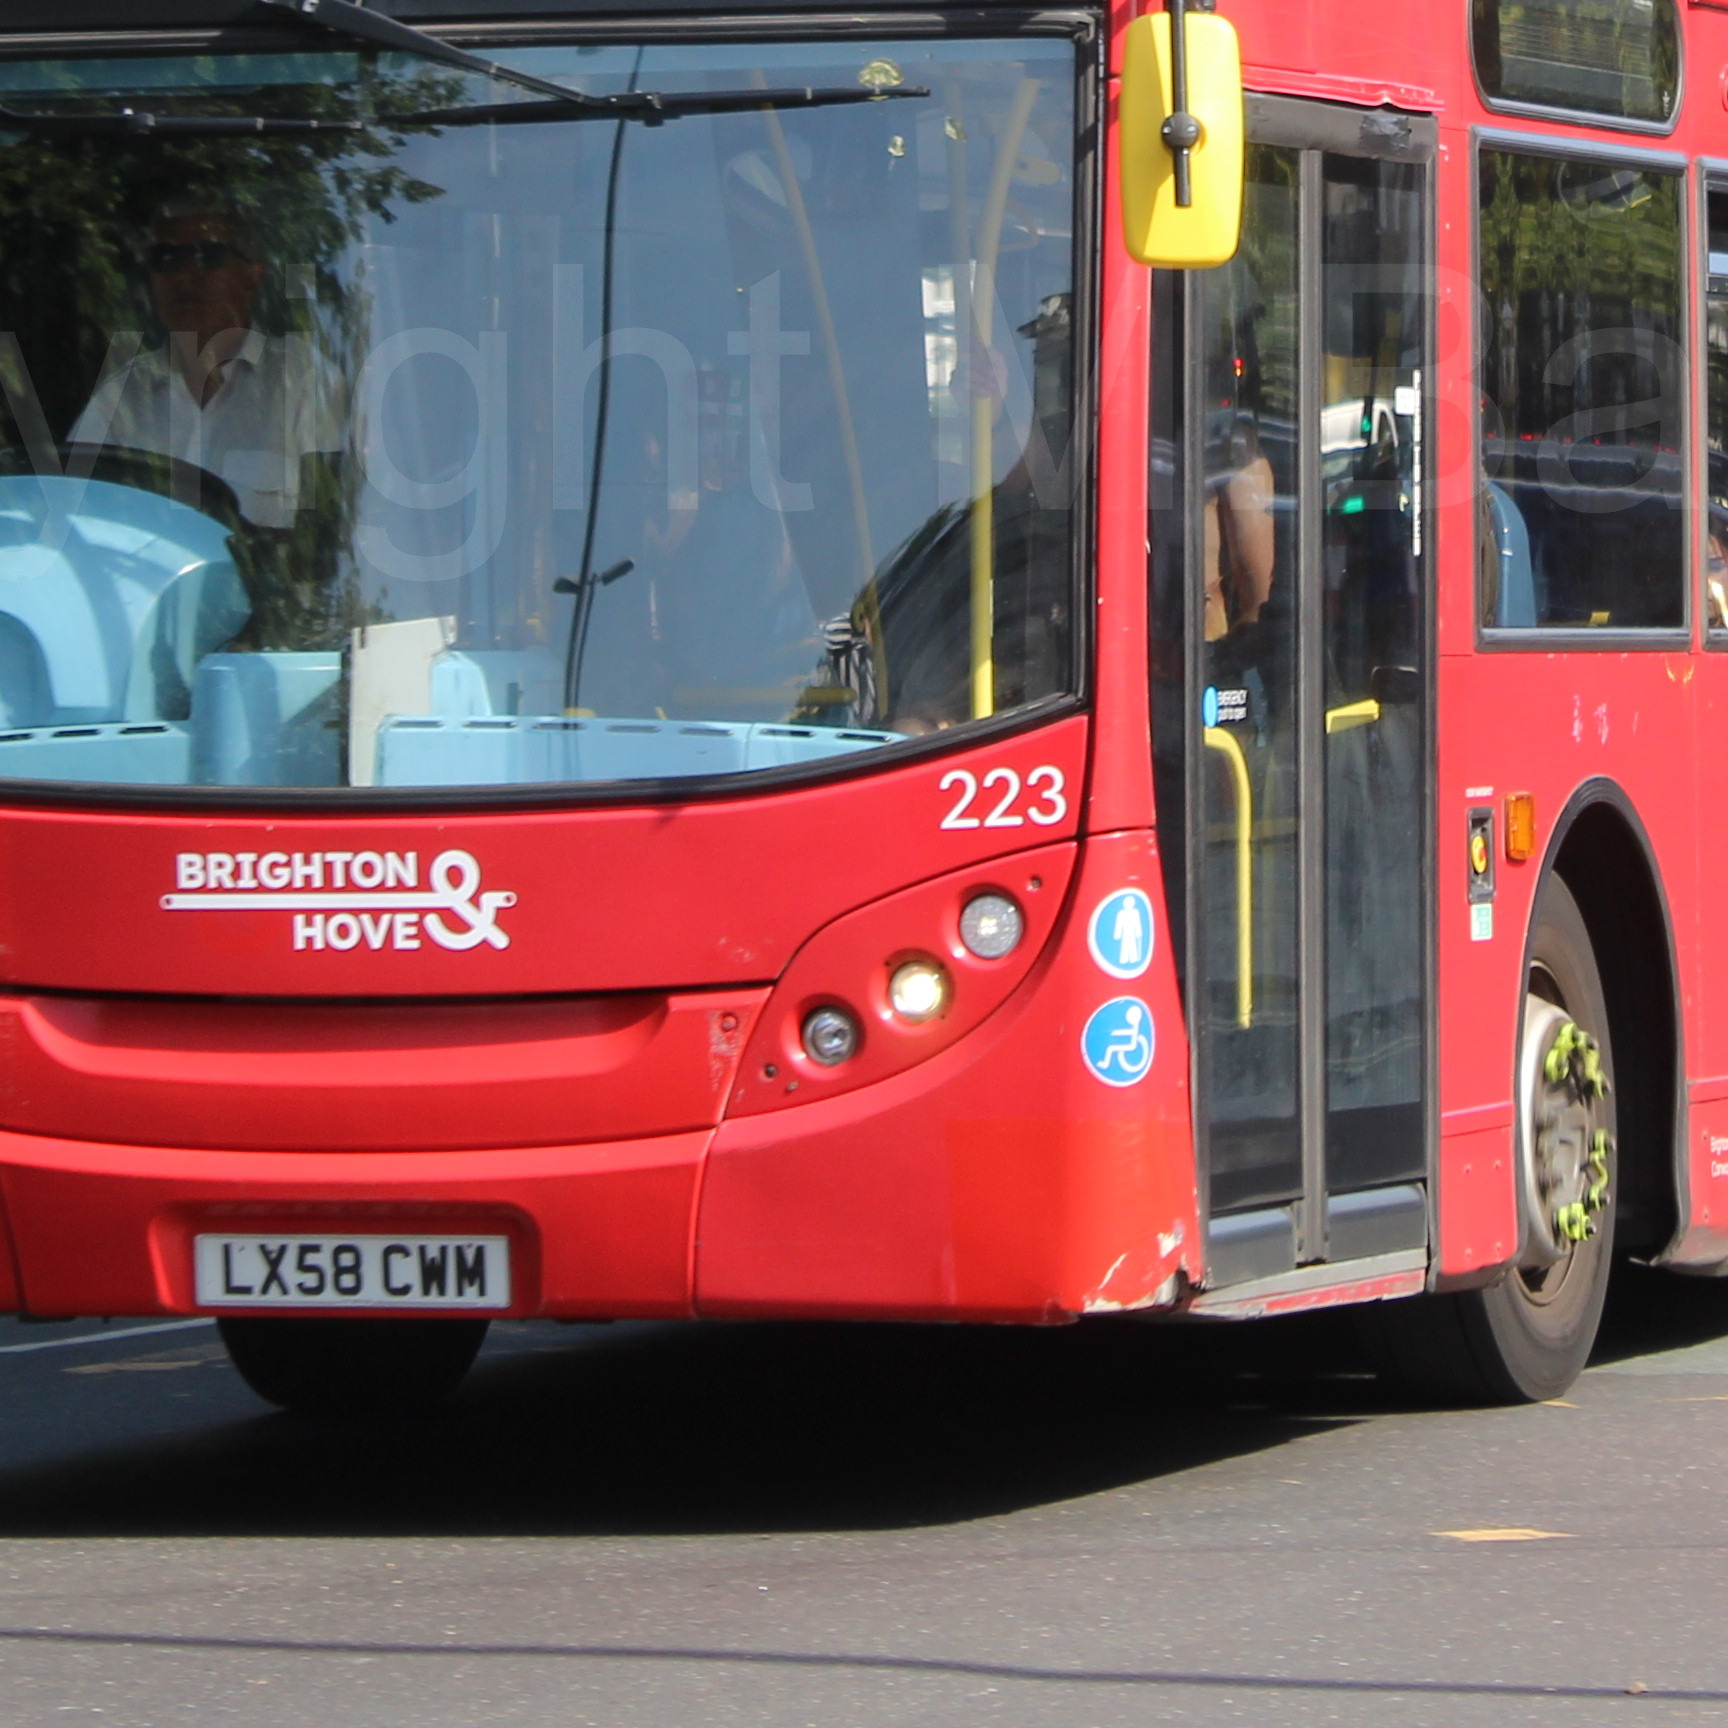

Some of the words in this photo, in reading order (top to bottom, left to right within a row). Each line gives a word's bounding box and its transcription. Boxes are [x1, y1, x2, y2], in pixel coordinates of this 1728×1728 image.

[940, 766, 1068, 831] 223
[178, 851, 419, 890] BRIGHTON
[423, 848, 518, 950] &
[294, 913, 422, 951] HOVE
[222, 1243, 364, 1298] LX58
[381, 1244, 488, 1300] CWM
